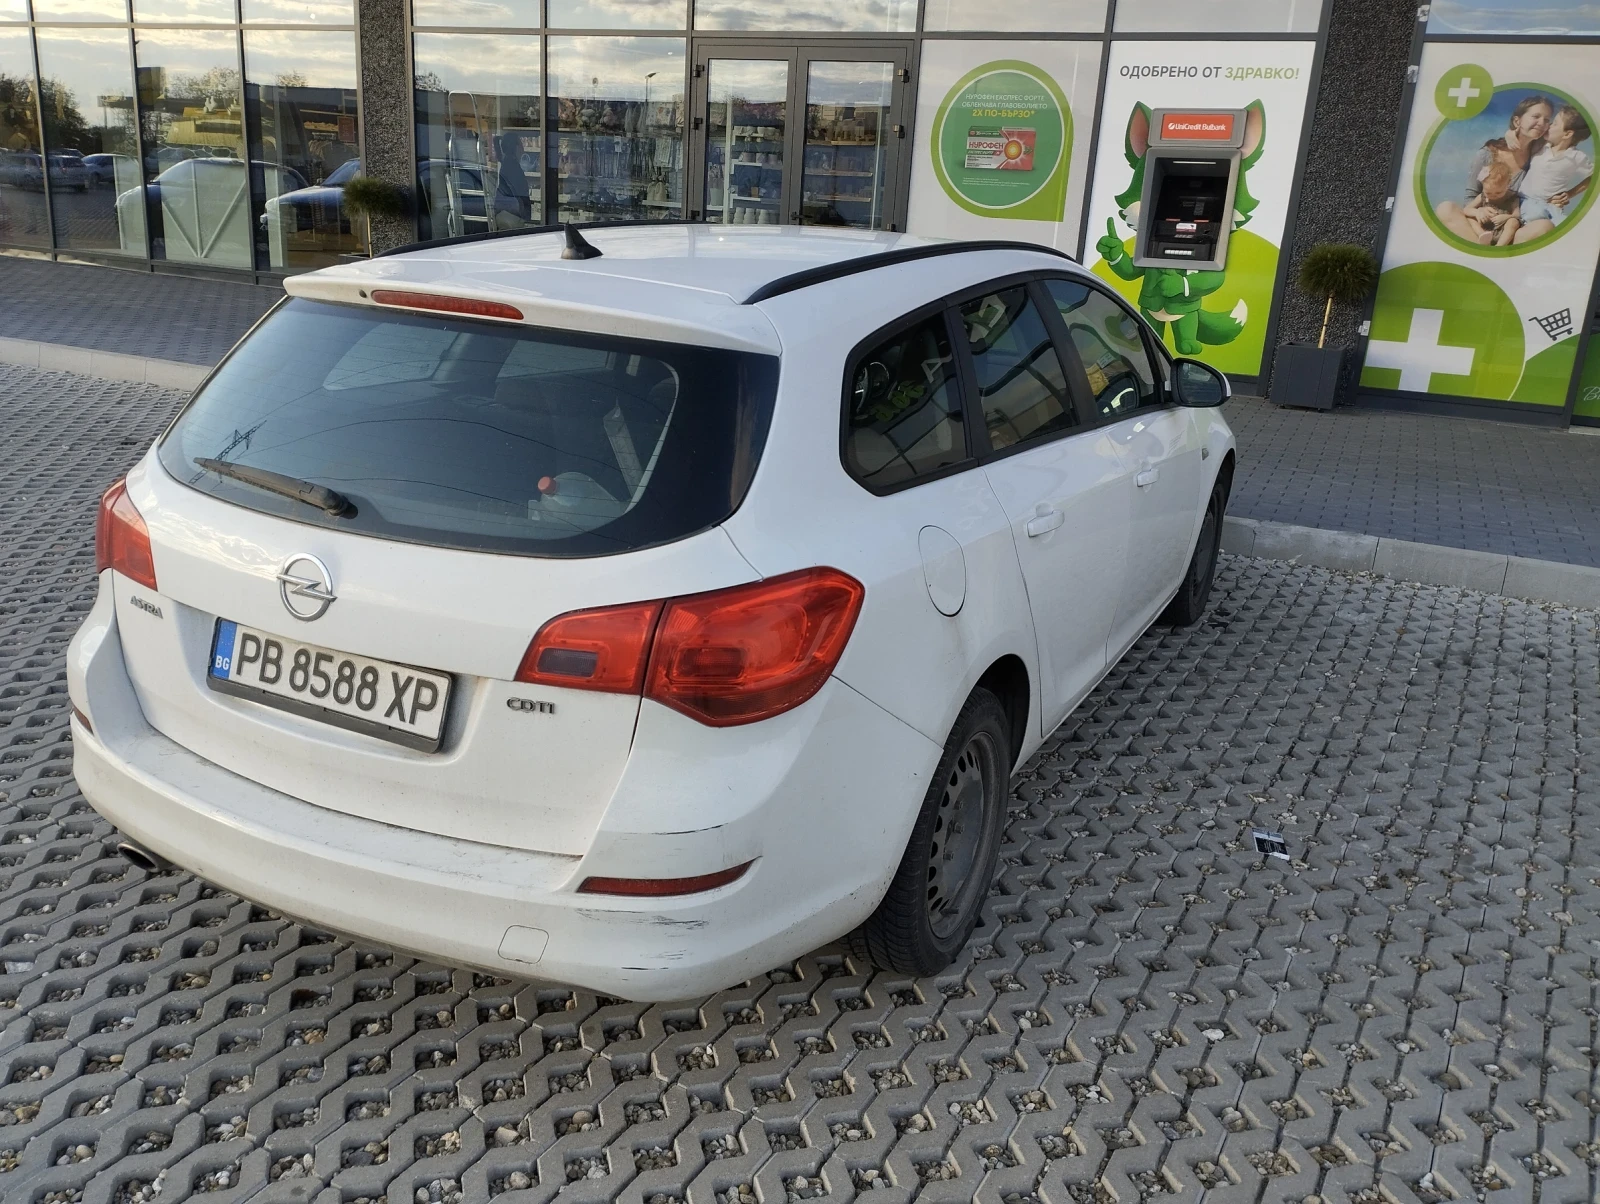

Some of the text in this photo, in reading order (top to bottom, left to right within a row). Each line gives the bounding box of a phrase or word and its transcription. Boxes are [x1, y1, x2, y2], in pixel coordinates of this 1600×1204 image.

[1119, 65, 1300, 81] ОДОБРЕНО ОТ ЗДРАВКО!
[1175, 122, 1227, 131] UniCredit Bulbank
[968, 141, 1004, 150] НУРОФЕН
[130, 595, 164, 619] ASTRA
[214, 654, 231, 671] BG
[288, 648, 380, 712] 8588
[506, 696, 556, 715] CDTI
